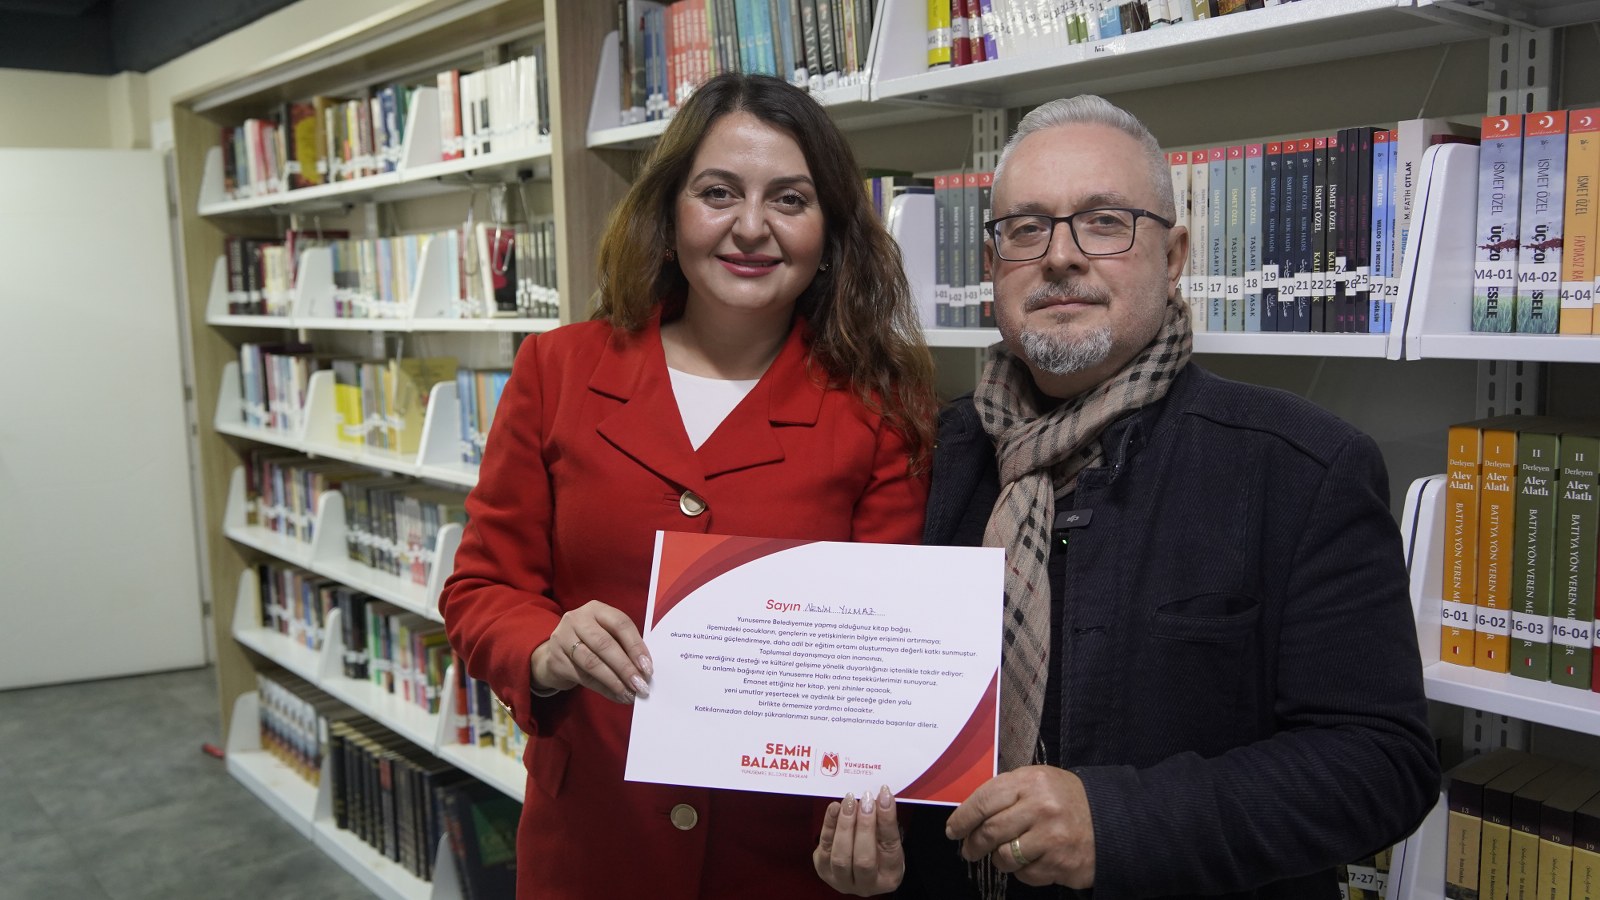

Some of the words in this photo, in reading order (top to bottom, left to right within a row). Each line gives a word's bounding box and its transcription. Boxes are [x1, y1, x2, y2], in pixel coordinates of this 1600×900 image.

[1404, 162, 1412, 188] ÇITLAK
[1493, 161, 1507, 190] İSMET
[1538, 158, 1552, 187] İSMET
[1577, 175, 1590, 197] İSMET
[1329, 184, 1337, 208] İSMET
[1491, 193, 1506, 216] ÖZEL
[1536, 190, 1550, 214] ÖZEL
[1404, 212, 1410, 220] M.
[1576, 198, 1588, 216] ÖZEL
[1314, 212, 1322, 233] ÖZEL
[1488, 225, 1504, 242] ÜÇ
[1532, 224, 1548, 243] ÜÇ
[1573, 236, 1586, 269] FAYDASIZ
[1370, 284, 1383, 293] 27
[1450, 458, 1475, 468] Derleyen
[1484, 460, 1511, 469] Derleyen
[1522, 464, 1550, 473] Derleyen
[1564, 467, 1594, 477] Derleyen
[1451, 471, 1472, 480] Alev
[1486, 473, 1508, 482] Alev
[1524, 476, 1546, 486] Alev
[1449, 480, 1474, 491] Alatlı
[1484, 482, 1510, 492] Alatlı
[1521, 486, 1549, 496] Alatlı
[1566, 480, 1590, 490] Alev
[1564, 490, 1593, 501] Alatlı
[1454, 537, 1463, 557] YÖN
[1490, 539, 1499, 560] YÖN
[1527, 545, 1537, 566] YÖN
[1570, 550, 1580, 571] YÖN
[1453, 559, 1462, 591] VEREN
[1488, 562, 1497, 594] VEREN
[1526, 568, 1535, 598] VEREN
[1568, 572, 1577, 605] VEREN
[766, 599, 801, 613] Sayın
[707, 623, 742, 633] ilçemizdeki
[818, 632, 856, 640] yetişkinlerin
[857, 633, 878, 643] bilgiye
[879, 635, 906, 643] erişimini
[738, 616, 772, 625] Yunusemre
[773, 618, 813, 628] Belediyemize
[814, 622, 838, 630] yapmış
[839, 623, 872, 632] olduğunuz
[873, 625, 890, 633] kitap
[671, 631, 692, 639] okuma
[693, 633, 723, 641] kültürünü
[773, 639, 791, 647] daha
[815, 641, 835, 650] eğitim
[859, 644, 899, 654] oluşturmaya
[900, 647, 924, 655] değerli
[760, 648, 792, 657] Toplumsal
[793, 650, 836, 660] dayanışmaya
[681, 652, 704, 660] eğitime
[705, 655, 736, 664] verdiğiniz
[737, 657, 761, 666] desteği
[770, 659, 795, 667] kültürel
[795, 661, 822, 669] gelişime
[823, 662, 845, 670] yönelik
[846, 664, 889, 674] duyarlılığınızı
[890, 666, 919, 675] içtenlikle
[703, 663, 712, 671] bu
[712, 665, 737, 673] anlamlı
[737, 665, 765, 676] bağışınız
[766, 669, 778, 677] için
[779, 670, 814, 679] Yunusemre
[815, 672, 832, 680] Halkı
[852, 675, 902, 684] teşekkürlerimizi
[904, 679, 938, 687] sunuyoruz.
[744, 677, 768, 686] Emanet
[769, 680, 795, 689] ettiğiniz
[796, 680, 807, 689] her
[808, 682, 826, 691] kitap,
[827, 684, 841, 692] yeni
[739, 688, 764, 696] umutlar
[765, 691, 800, 699] yeşertecek
[810, 693, 836, 701] aydınlık
[836, 694, 846, 702] bir
[847, 696, 877, 705] geleceğe
[878, 697, 897, 706] giden
[759, 699, 781, 708] birlikte
[782, 701, 813, 710] örmemize
[814, 704, 843, 712] yardımcı
[844, 705, 875, 714] olacaktır.
[695, 705, 743, 715] Katkılarınızdan
[743, 709, 764, 718] dolayı
[765, 711, 809, 720] şükranlarımızı
[831, 716, 885, 725] çalışmalarınızda
[886, 719, 916, 727] başarılar
[917, 721, 939, 729] dileriz.
[741, 755, 810, 771] BALABAN
[844, 762, 881, 770] YUNUSEMRE
